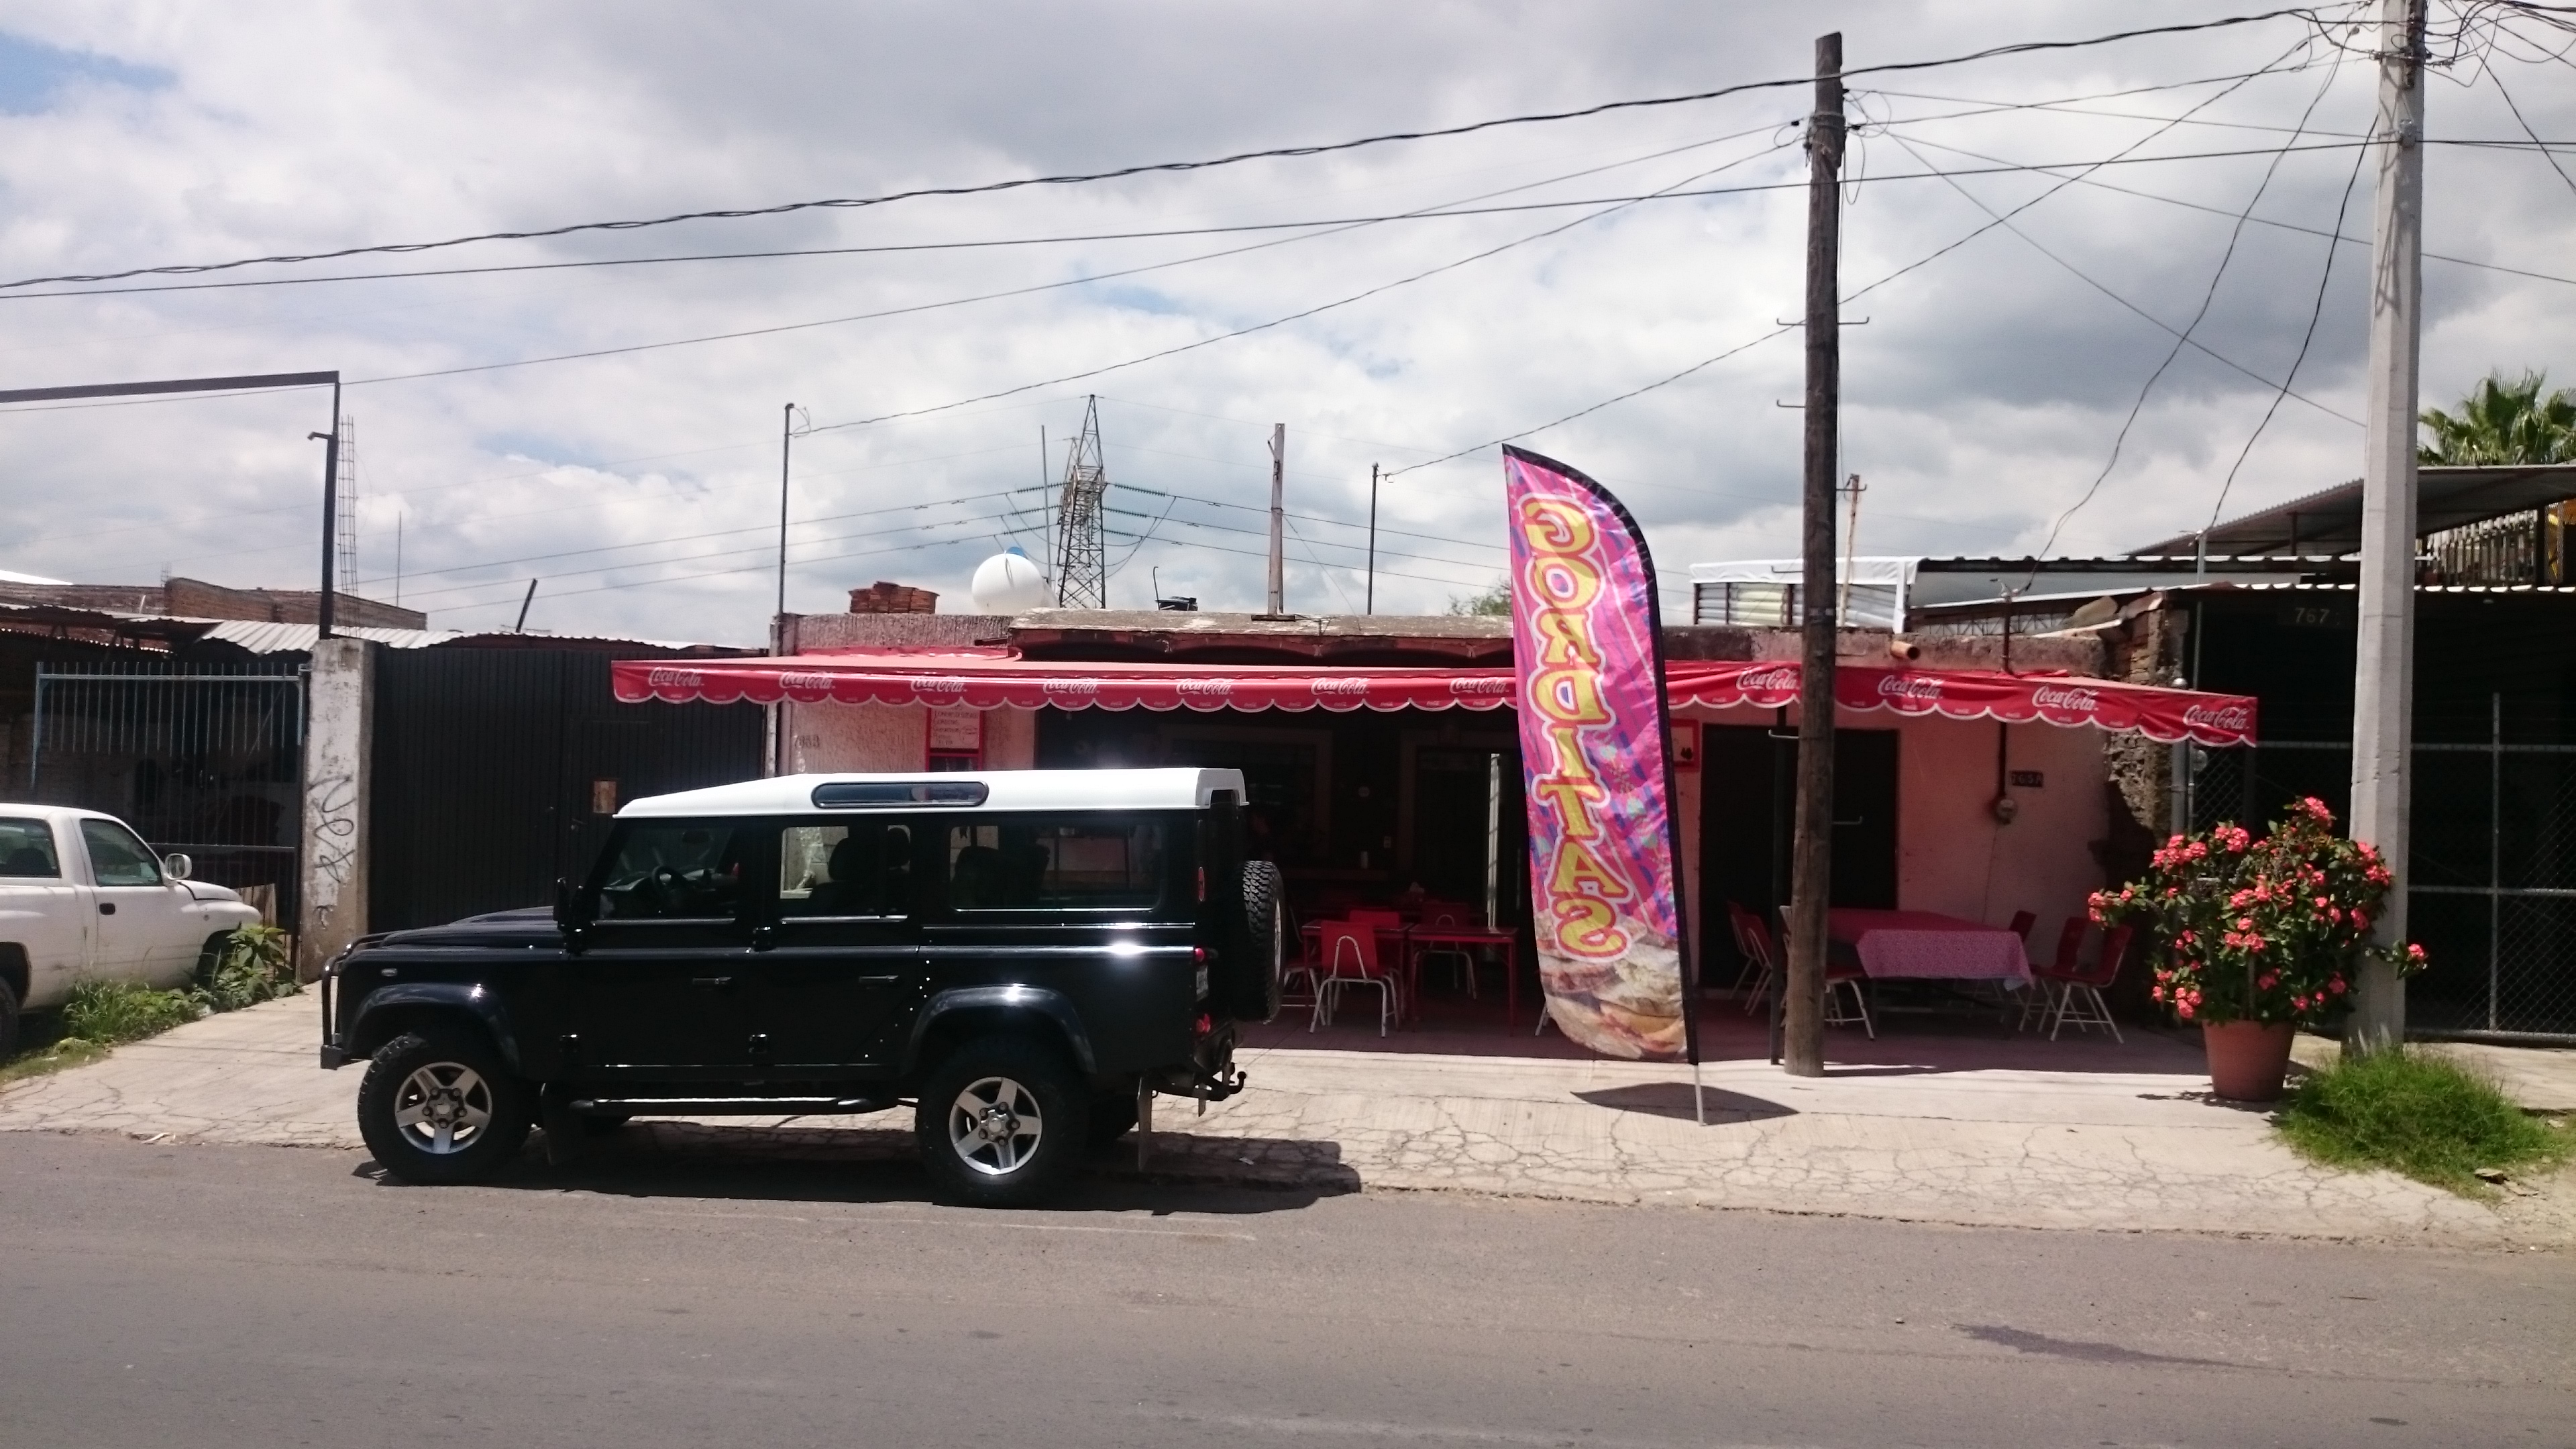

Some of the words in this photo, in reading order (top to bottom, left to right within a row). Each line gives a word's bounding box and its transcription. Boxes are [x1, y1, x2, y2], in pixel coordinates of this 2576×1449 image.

[2295, 606, 2330, 625] 767
[648, 667, 702, 686] Coca-Cola
[1449, 676, 1507, 694] Coca-Cola
[1736, 669, 1799, 690] Coca-Cola
[1176, 678, 1233, 695] Coca-Cola
[1311, 678, 1368, 695] Coca-Cola
[1878, 675, 1943, 700] Coca-Cola
[2032, 686, 2099, 711] Coca-Cola
[2183, 705, 2249, 730] Coca-Cola
